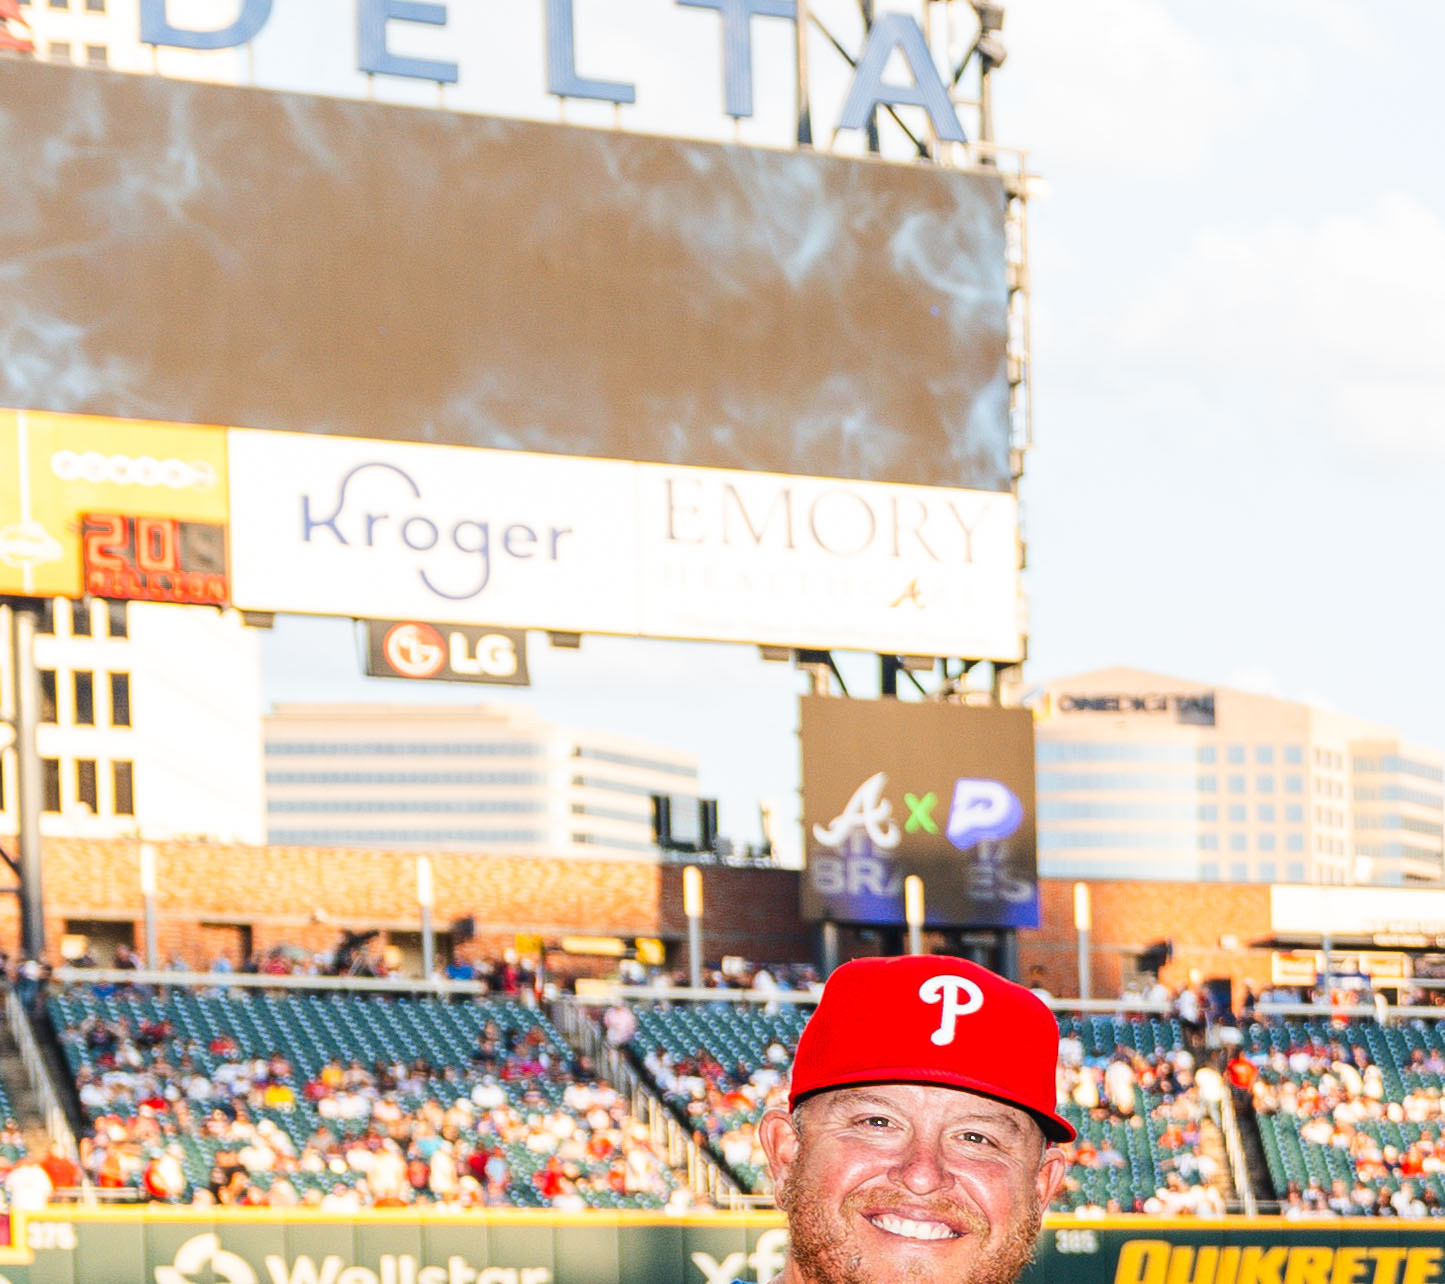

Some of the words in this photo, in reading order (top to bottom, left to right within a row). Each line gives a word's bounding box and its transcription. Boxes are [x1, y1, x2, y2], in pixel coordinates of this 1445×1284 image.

[302, 462, 574, 600] Kroger
[664, 477, 992, 565] EMORY
[450, 633, 518, 677] LG
[919, 974, 984, 1047] P
